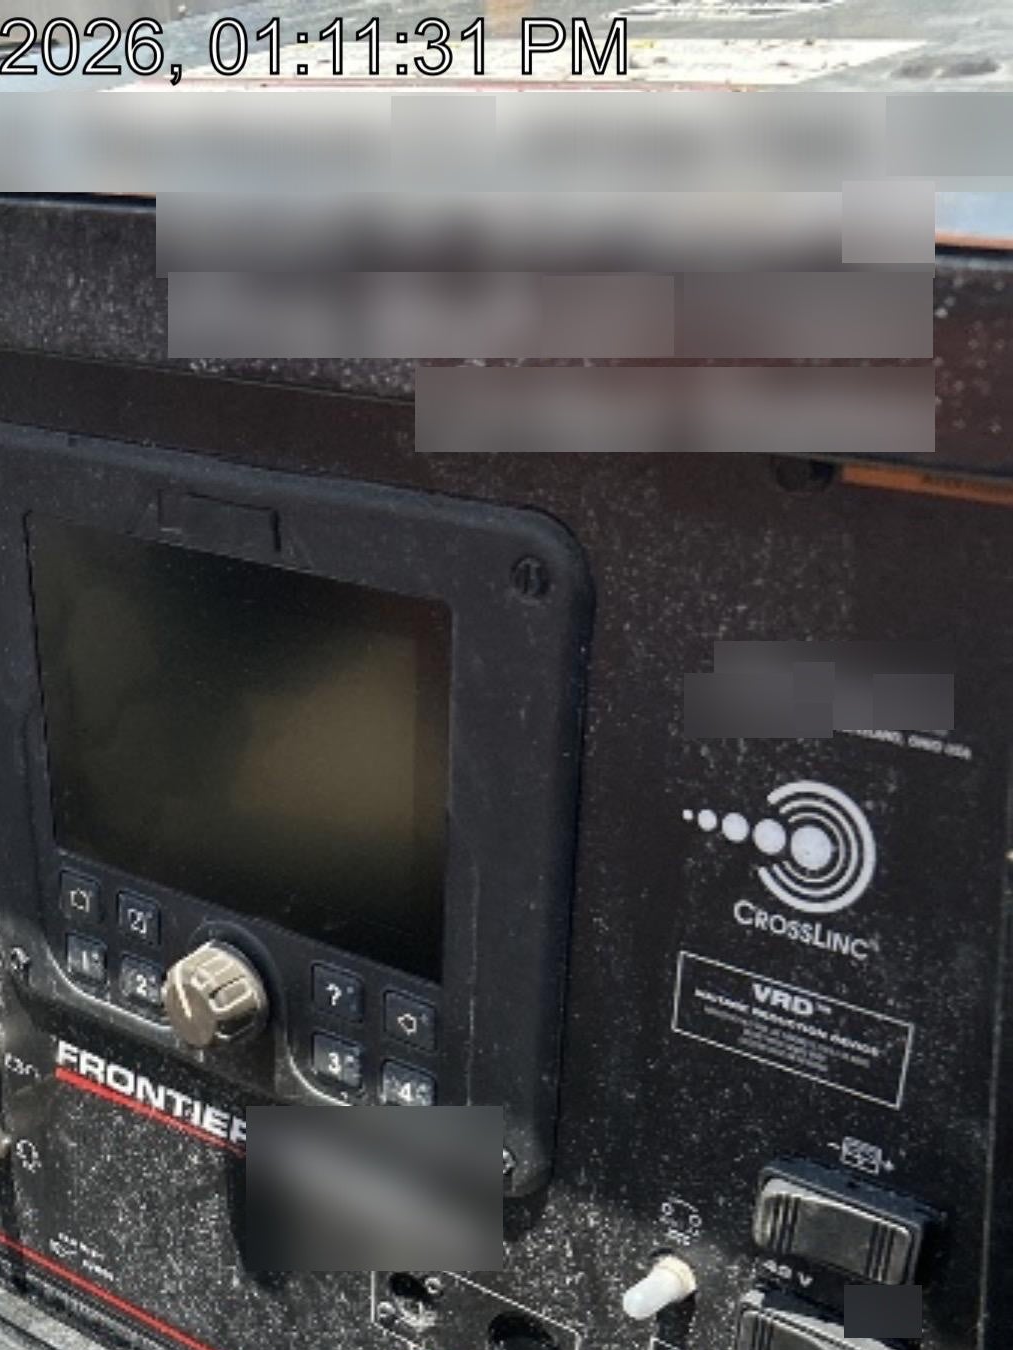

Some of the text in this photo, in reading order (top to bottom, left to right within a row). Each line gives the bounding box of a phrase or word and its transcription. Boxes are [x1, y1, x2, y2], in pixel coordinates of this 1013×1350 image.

[135, 973, 148, 997] 2
[327, 1051, 341, 1076] 3
[397, 1081, 413, 1103] 4
